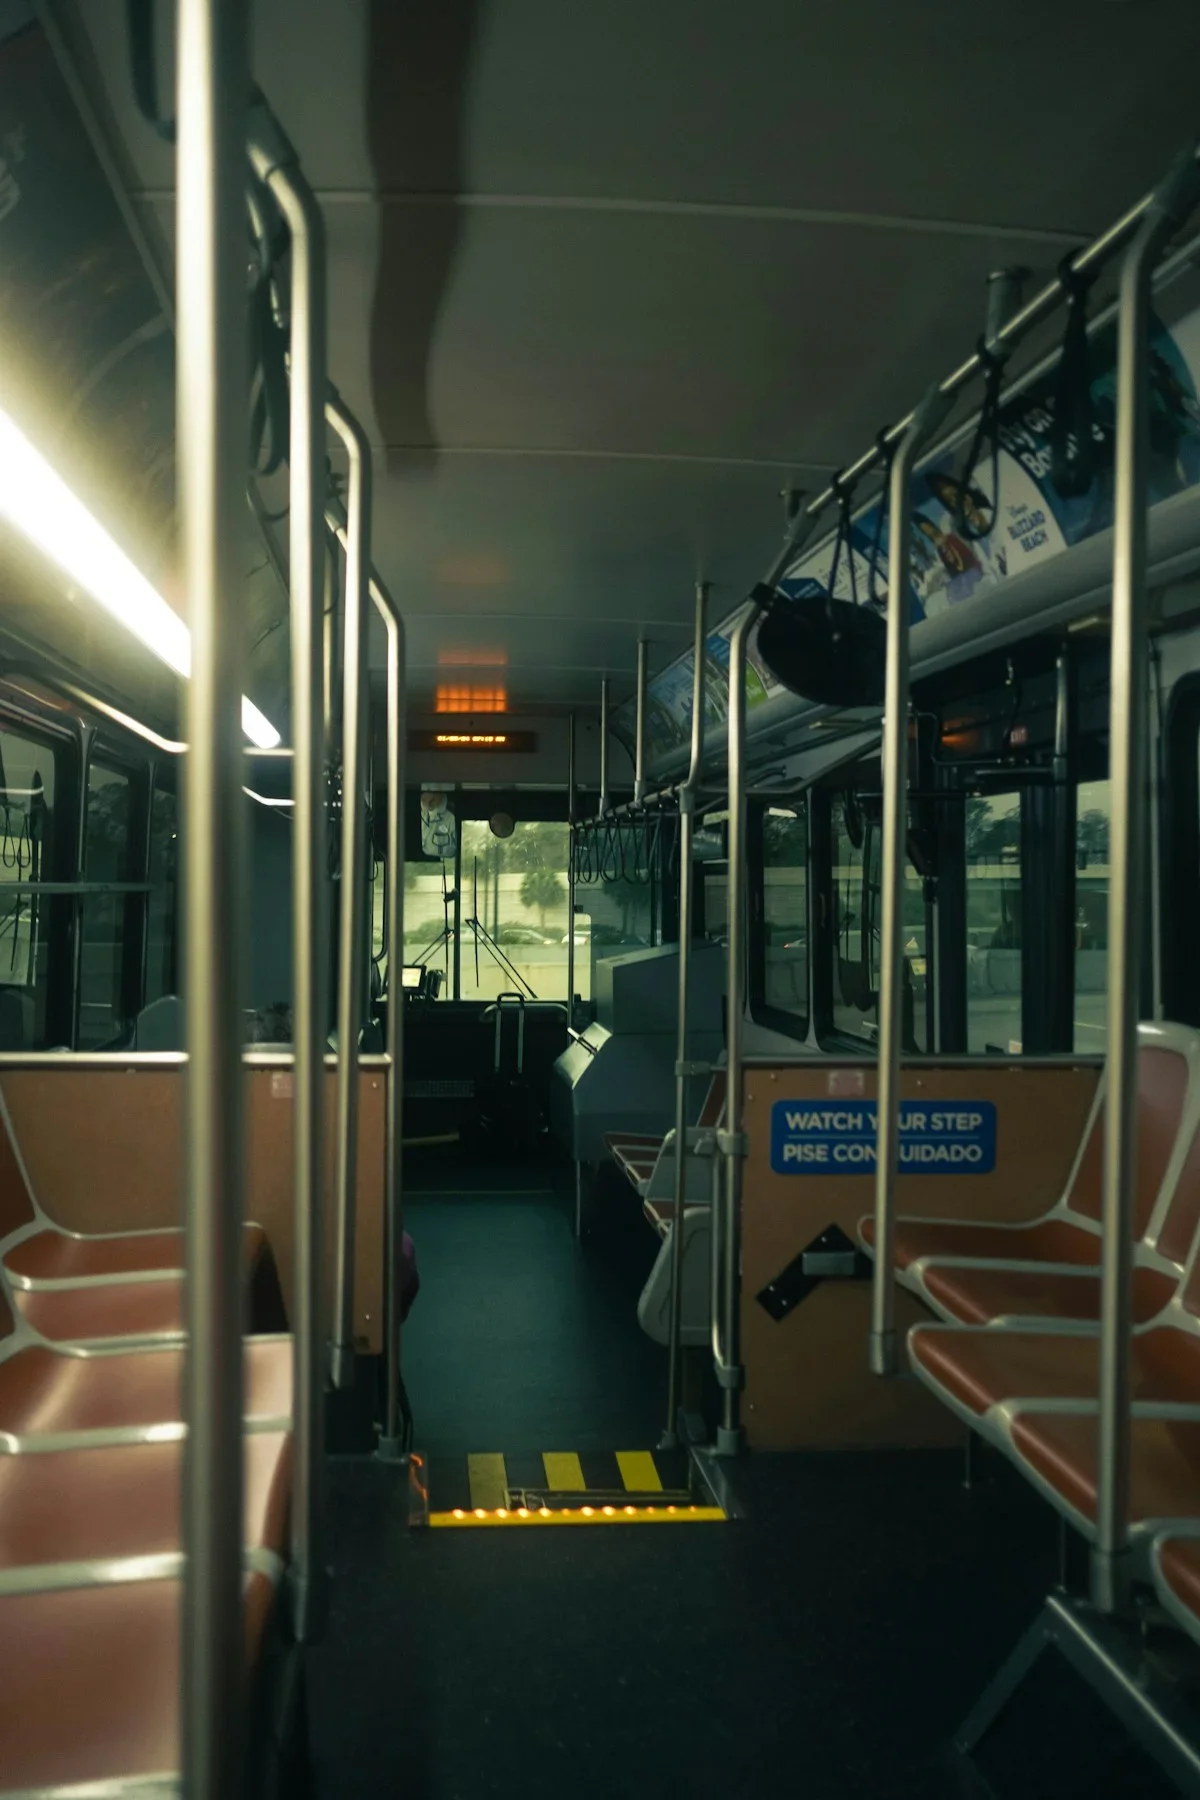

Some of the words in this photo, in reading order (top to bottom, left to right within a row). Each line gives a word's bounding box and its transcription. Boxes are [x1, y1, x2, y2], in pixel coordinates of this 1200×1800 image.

[785, 1112, 863, 1131] WATCH
[868, 1112, 927, 1131] YUR
[931, 1113, 983, 1131] STEP
[783, 1144, 829, 1162] PISE
[833, 1144, 878, 1162] CON
[899, 1144, 983, 1162] UIDADO
